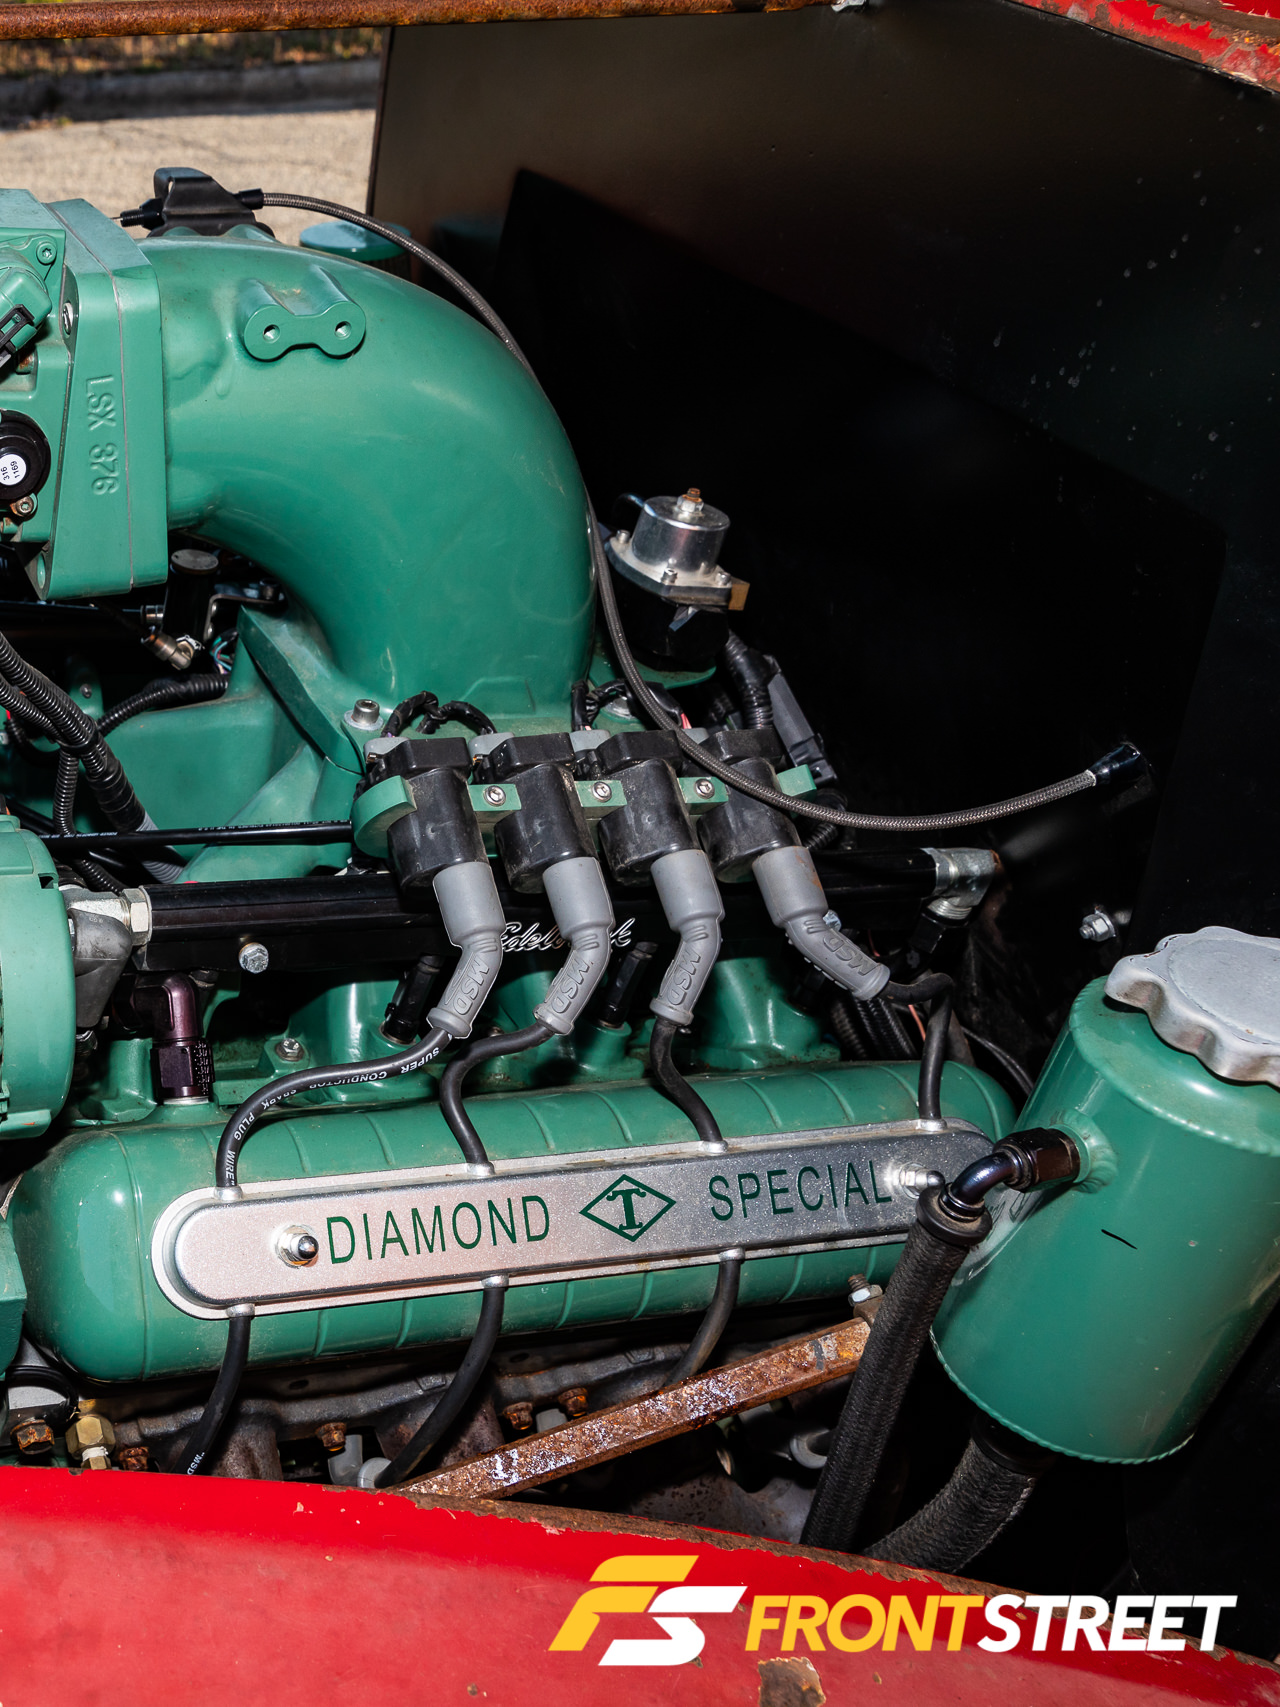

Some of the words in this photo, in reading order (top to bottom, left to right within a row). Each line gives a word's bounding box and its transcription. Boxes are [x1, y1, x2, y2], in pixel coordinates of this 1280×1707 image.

[86, 374, 116, 431] LSX
[0, 466, 10, 481] 316
[10, 460, 20, 478] 1169
[88, 442, 120, 495] 376
[551, 950, 591, 1014] MSD
[667, 948, 701, 1006] MSD
[823, 935, 878, 976] MSD
[453, 952, 490, 1015] MSD
[400, 1047, 440, 1074] SUPER
[233, 1111, 255, 1141] PLUG
[326, 1195, 550, 1264] DIAMOND
[708, 1160, 892, 1221] SPECIAL
